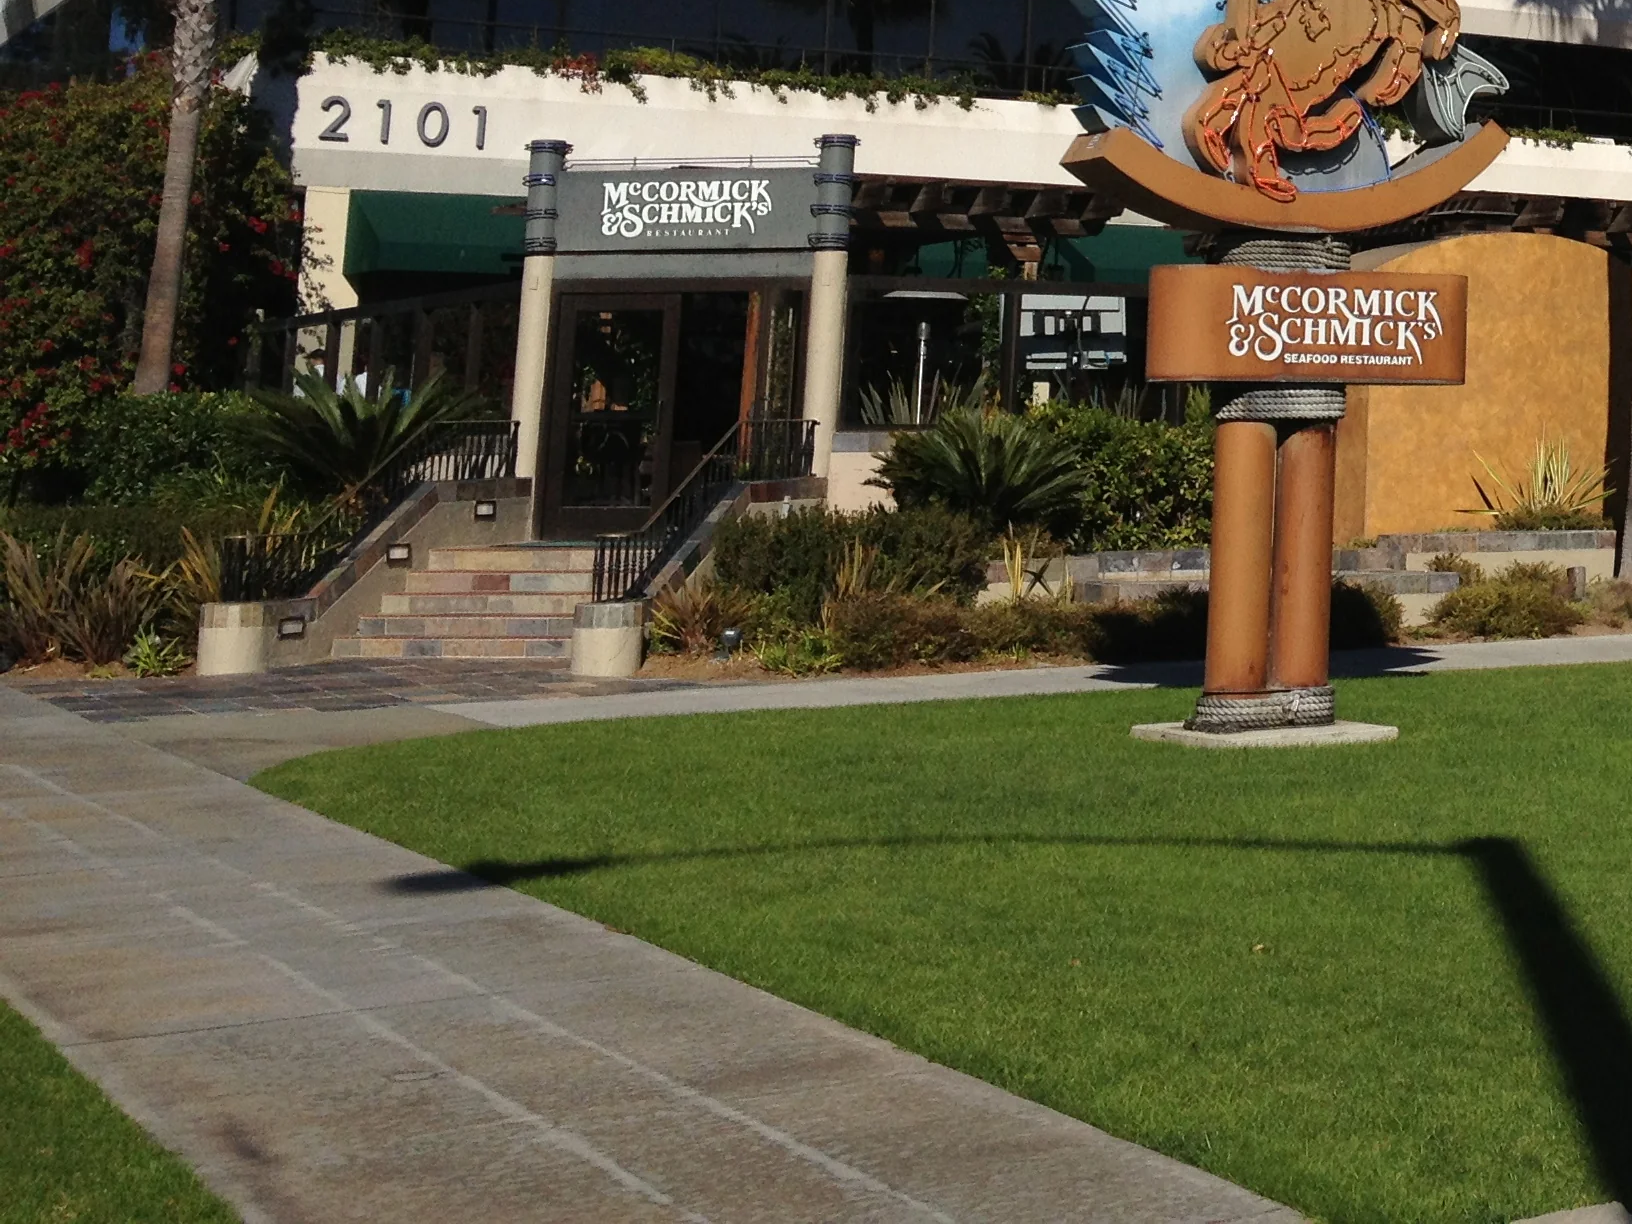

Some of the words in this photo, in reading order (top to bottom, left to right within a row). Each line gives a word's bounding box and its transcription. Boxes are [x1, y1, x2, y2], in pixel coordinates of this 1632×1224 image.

[318, 95, 488, 151] 2101
[601, 212, 623, 236] &
[646, 228, 730, 237] RESTAURANT
[1228, 323, 1255, 357] &
[1254, 312, 1436, 365] SCHMICK'S
[1283, 352, 1338, 364] SEAFOOD
[1340, 354, 1414, 366] RESTAURANT
